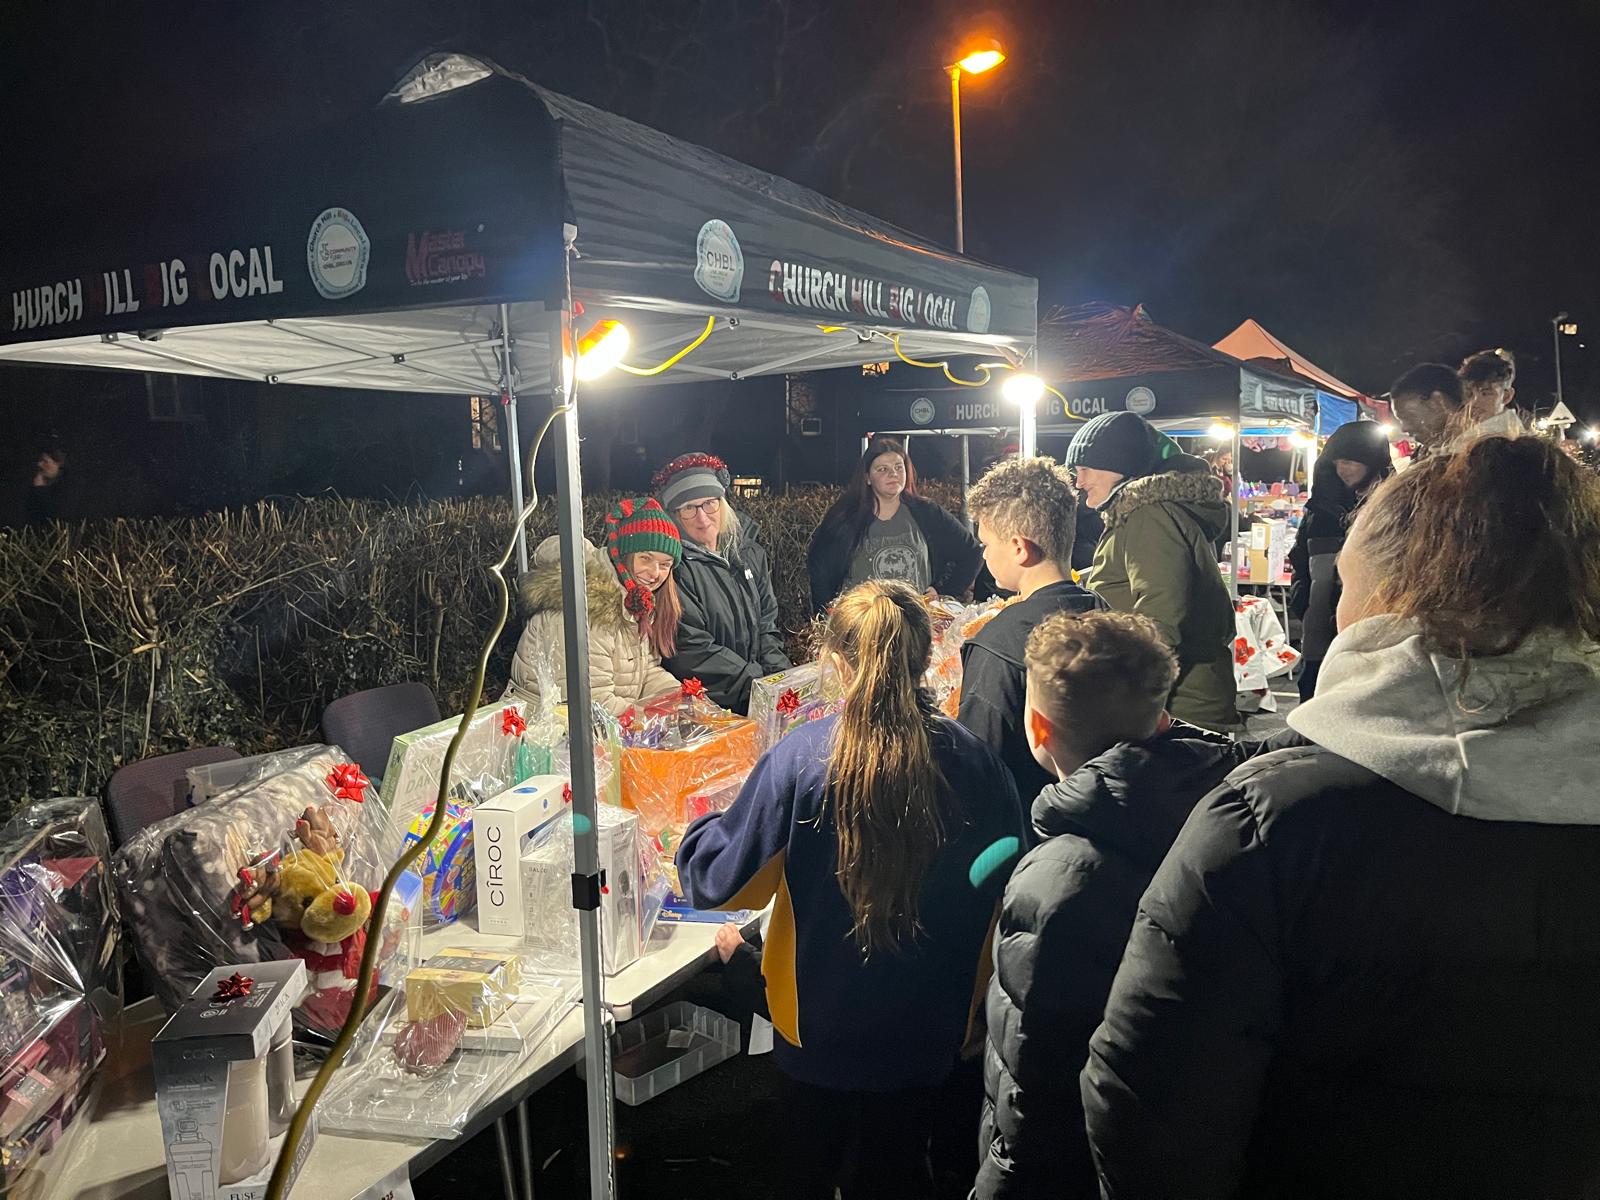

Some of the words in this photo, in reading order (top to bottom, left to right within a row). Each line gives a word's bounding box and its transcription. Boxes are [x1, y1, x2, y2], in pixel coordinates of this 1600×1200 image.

[706, 250, 736, 272] CHBL
[12, 278, 83, 332] HURCH
[100, 268, 140, 316] ILL
[156, 258, 190, 307] IG
[208, 245, 284, 300] OCAL
[768, 259, 850, 314] CHURCH
[850, 277, 890, 319] HILL
[955, 403, 1000, 421] HURCH
[1072, 397, 1109, 414] OCAL
[486, 826, 505, 907] CÎROC
